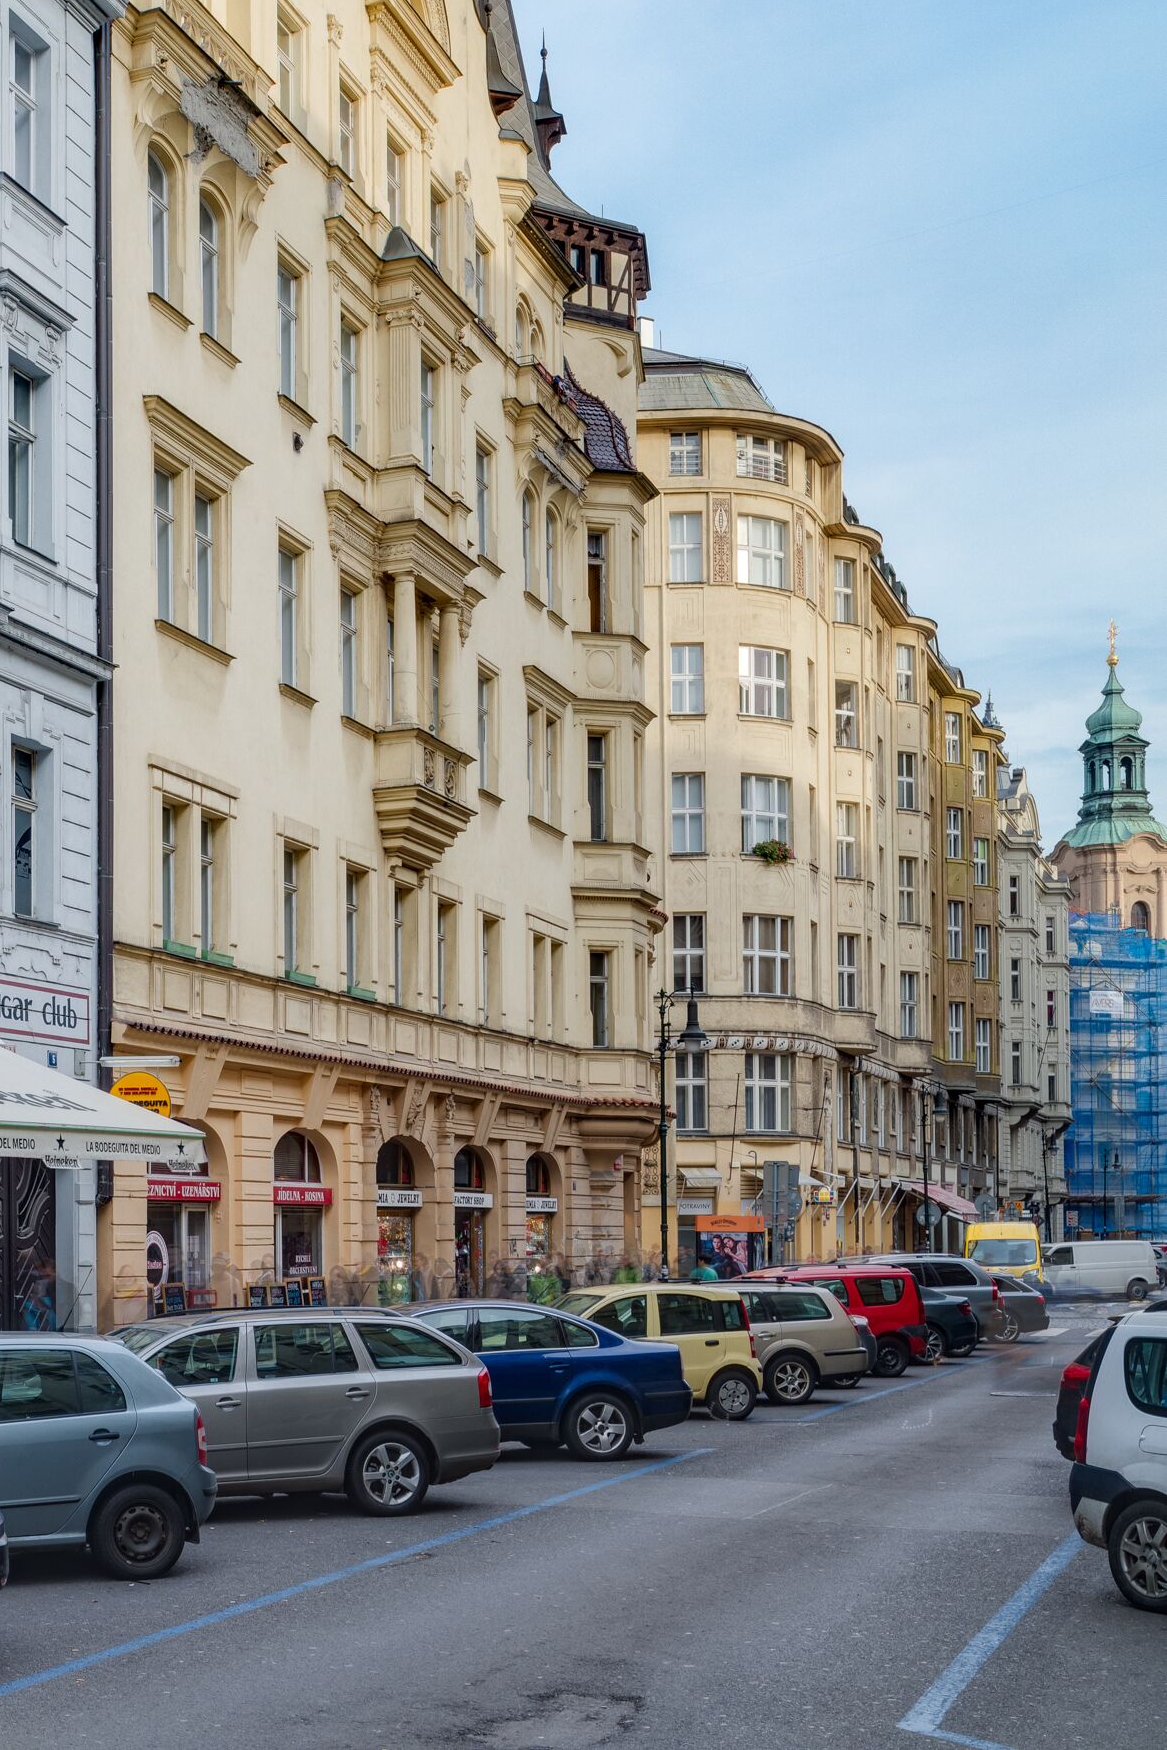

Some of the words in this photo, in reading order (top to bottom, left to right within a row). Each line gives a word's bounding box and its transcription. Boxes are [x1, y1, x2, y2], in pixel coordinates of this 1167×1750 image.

[43, 995, 77, 1029] club
[13, 1138, 36, 1150] MEDIO
[86, 1141, 94, 1152] LA
[95, 1142, 127, 1153] BODEGUITA
[129, 1143, 140, 1154] DEL
[141, 1144, 161, 1155] MEDIO
[277, 1189, 301, 1201] JÍDELNA
[397, 1193, 419, 1204] JEWELRY
[454, 1195, 473, 1204] FACTORY
[473, 1196, 485, 1206] SHOP
[540, 1200, 557, 1209] JEWELRY
